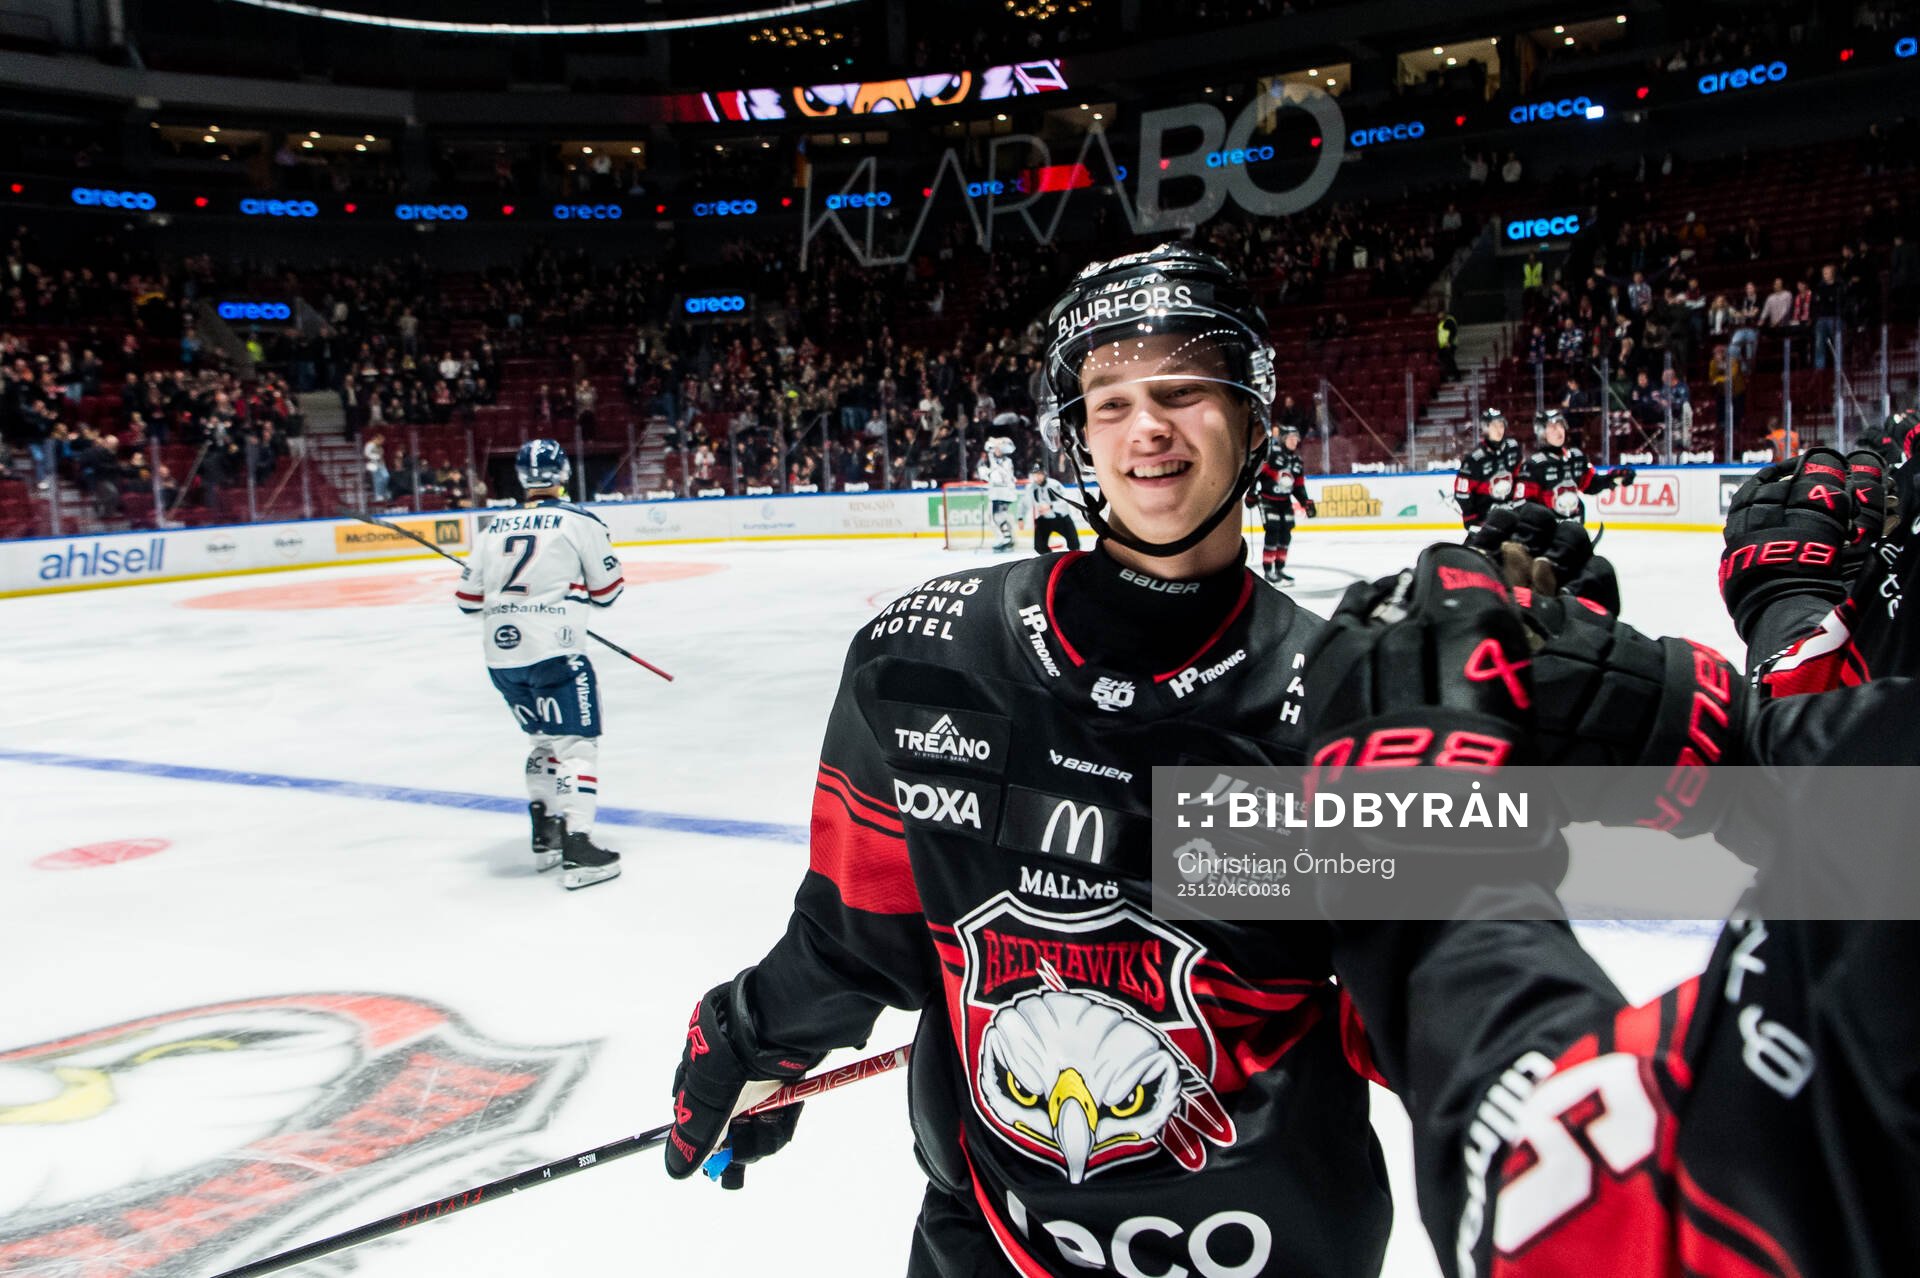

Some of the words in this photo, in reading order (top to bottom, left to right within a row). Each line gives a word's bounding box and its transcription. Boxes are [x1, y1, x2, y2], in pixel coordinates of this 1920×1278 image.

[1698, 61, 1788, 95] areco
[1510, 96, 1592, 123] areco
[1351, 121, 1425, 147] areco
[1205, 146, 1275, 169] areco
[72, 187, 157, 211] areco
[240, 198, 319, 218] areco
[693, 199, 758, 217] areco
[825, 191, 892, 211] areco
[396, 204, 469, 221] areco
[553, 204, 623, 221] areco
[217, 302, 292, 321] areco
[684, 295, 746, 314] areco
[1057, 285, 1193, 338] BJURFORS
[1601, 483, 1676, 506] JULA
[489, 515, 564, 534] RISSANEN
[39, 538, 165, 581] ahlsell
[502, 534, 537, 595] 2
[881, 595, 964, 617] ARENA
[871, 615, 954, 641] HOTEL
[1091, 683, 1135, 709] 50
[894, 727, 991, 761] TREANO
[893, 778, 982, 829] DOXA
[1018, 866, 1119, 900] MALMÖ
[982, 930, 1165, 1013] REDHAWKS
